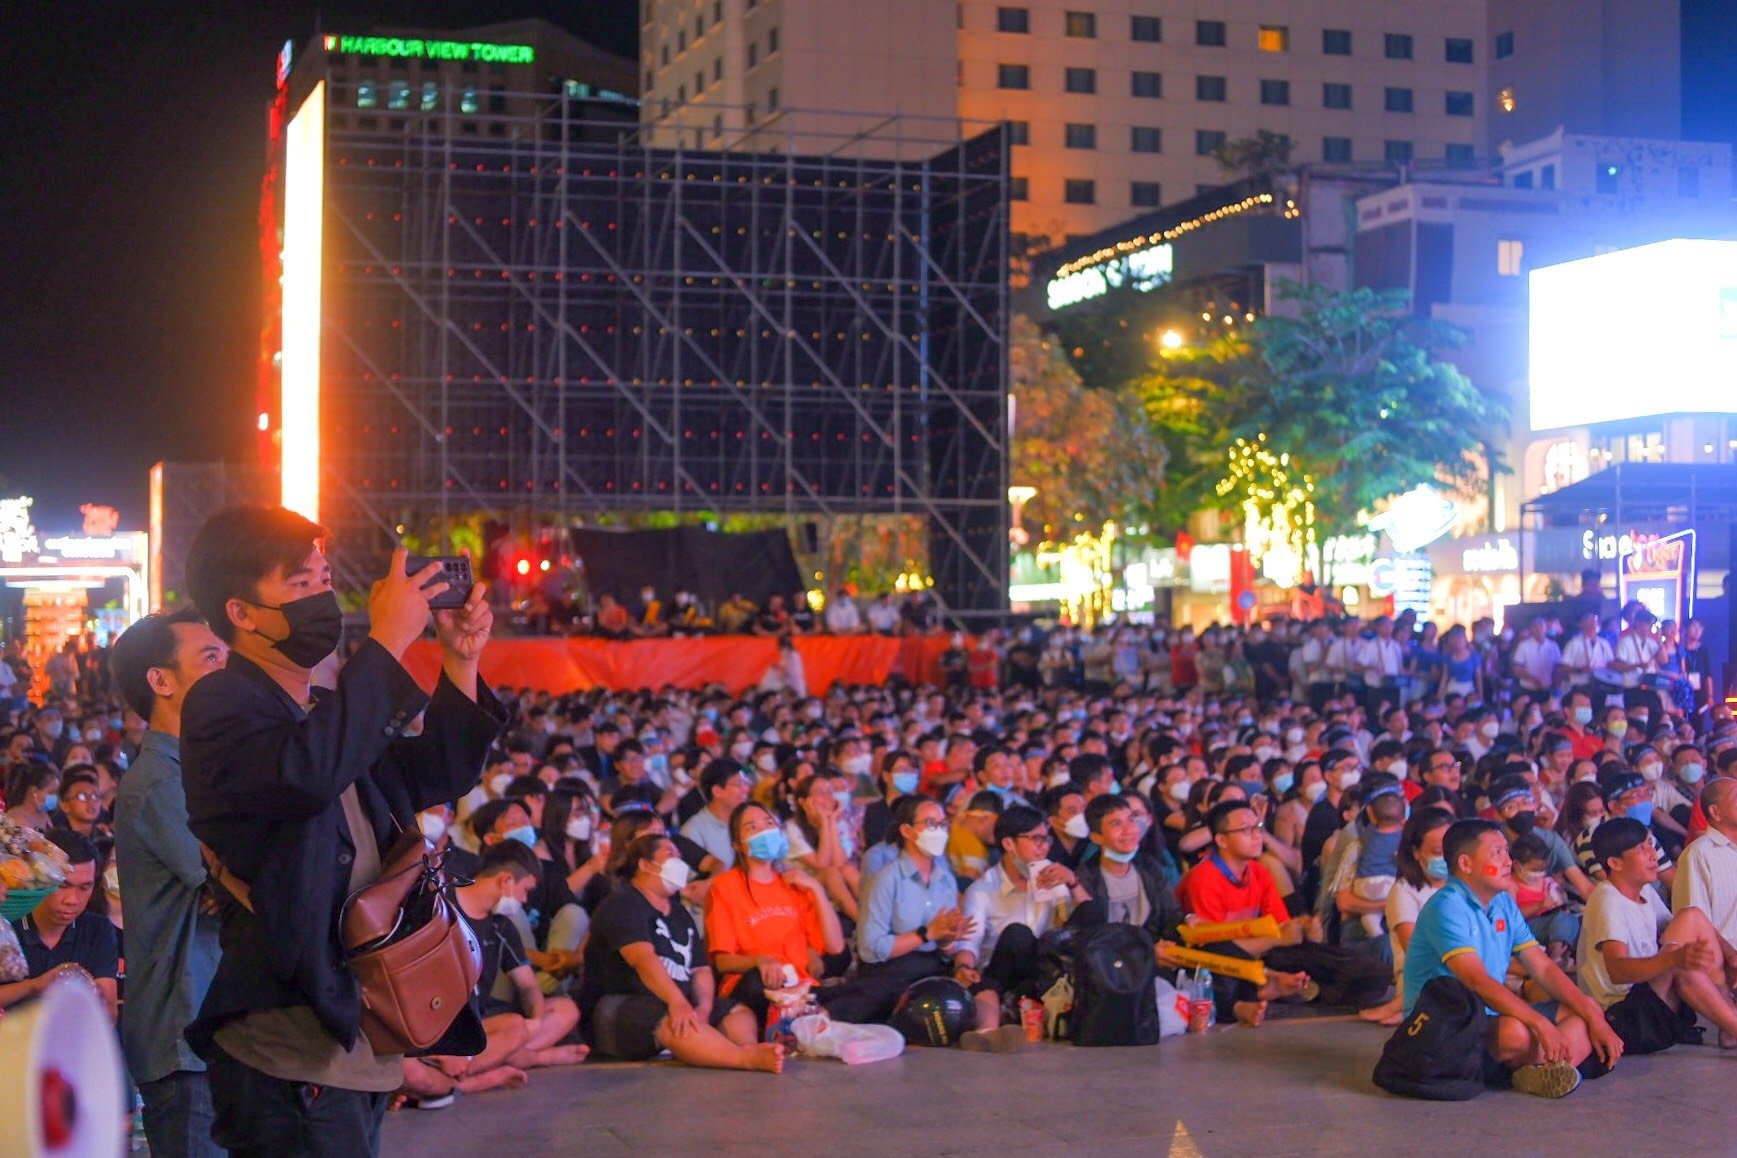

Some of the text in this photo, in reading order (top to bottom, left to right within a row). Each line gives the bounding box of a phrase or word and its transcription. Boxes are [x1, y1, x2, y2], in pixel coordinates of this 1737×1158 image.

[340, 36, 534, 63] HARBOUR VIEW TOWER
[1407, 1012, 1430, 1037] 5
